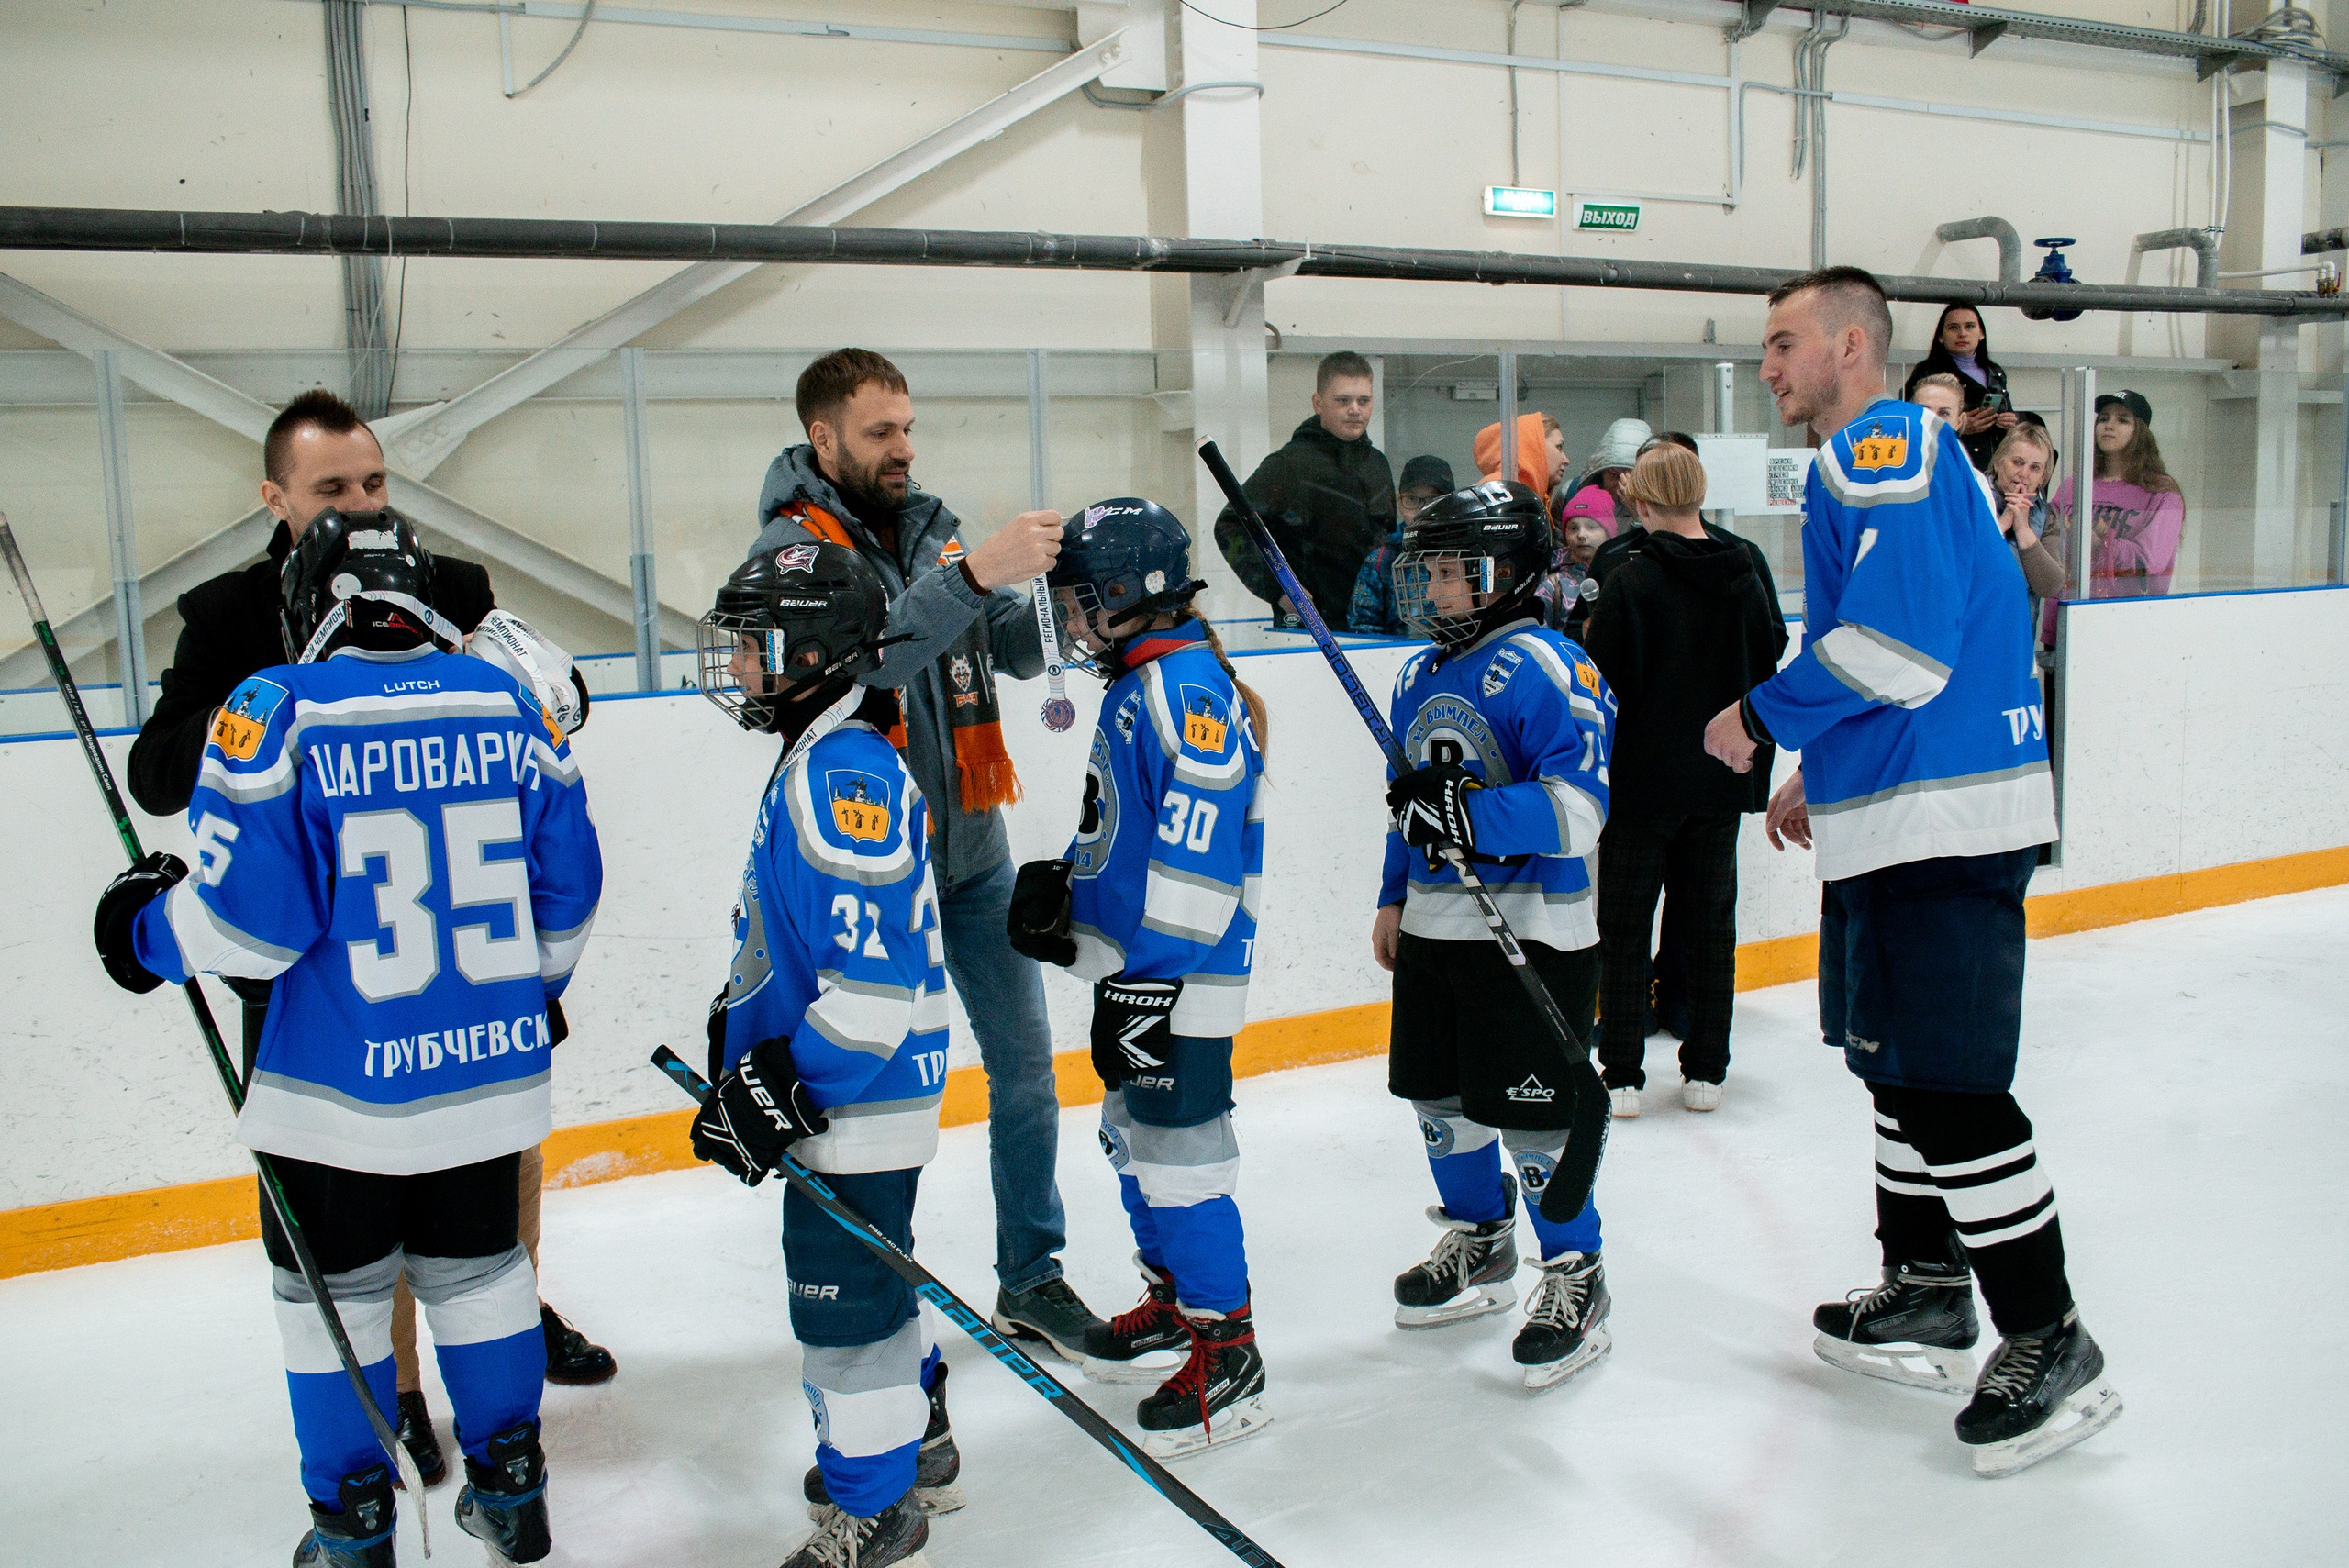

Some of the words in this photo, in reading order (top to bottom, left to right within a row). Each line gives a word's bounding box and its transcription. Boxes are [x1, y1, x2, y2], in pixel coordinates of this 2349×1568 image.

[1582, 210, 1637, 228] ВЫХОД
[1106, 506, 1144, 516] CM
[1483, 523, 1519, 531] BAUER
[780, 598, 828, 608] BAUER
[1033, 576, 1054, 643] РЕГИОНАЛЬНЫЙ
[491, 615, 529, 658] ЧЕМПИОНАТ
[384, 679, 440, 694] LUTCH
[1321, 641, 1390, 745] RIBCOR
[1426, 704, 1488, 744] ВЫМПЕЛ
[1157, 789, 1219, 854] 30
[1074, 849, 1093, 869] 14
[338, 796, 541, 1005] 35
[830, 893, 889, 960] 32
[364, 1010, 551, 1079] ТРУБЧЕВСК
[912, 1048, 949, 1087] ТР
[740, 1049, 793, 1132] AUER
[896, 1247, 914, 1264] FLEX
[787, 1277, 840, 1301] AUER
[916, 1282, 1063, 1401] BAUER
